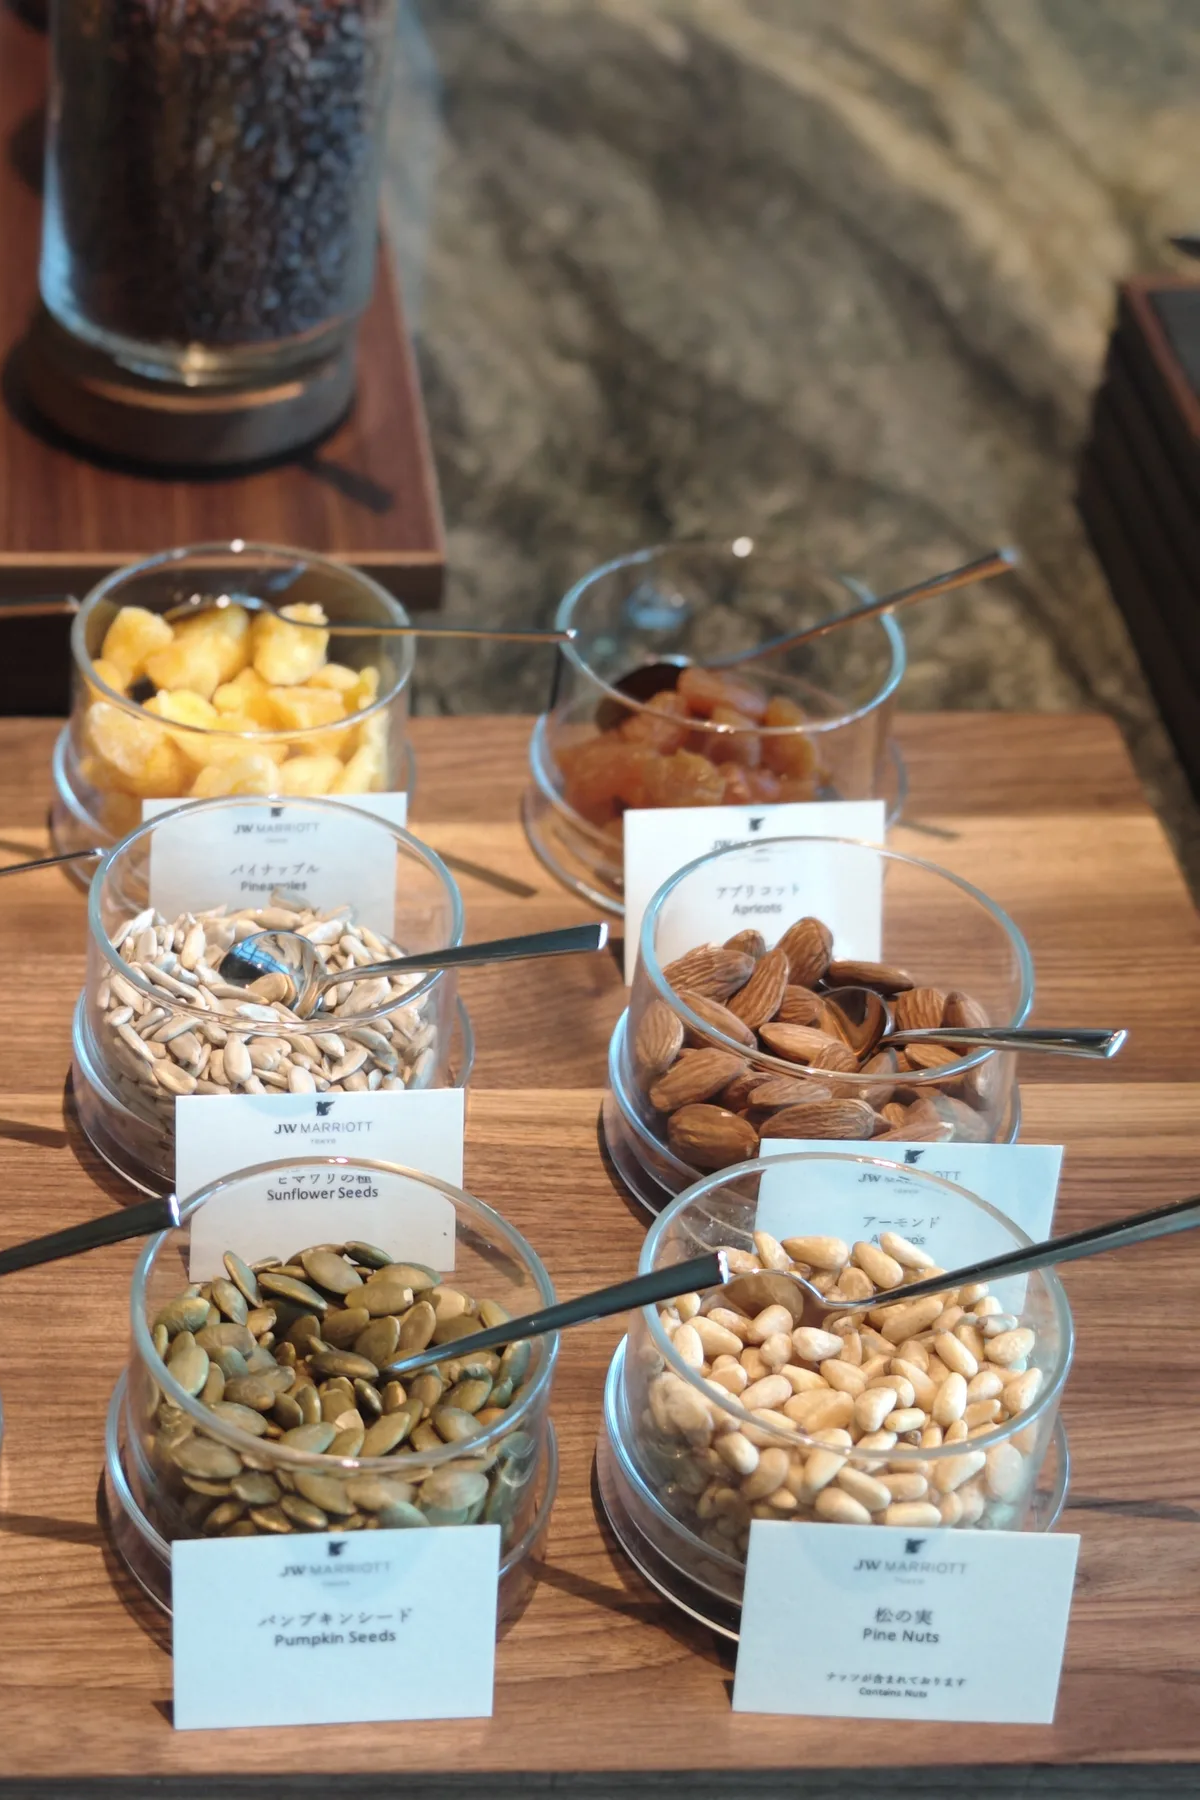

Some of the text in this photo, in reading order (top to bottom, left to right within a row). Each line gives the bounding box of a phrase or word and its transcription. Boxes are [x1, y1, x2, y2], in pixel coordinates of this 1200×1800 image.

[233, 822, 320, 835] JW MARRIOTT
[732, 903, 783, 915] Apricots
[274, 1121, 373, 1135] JW MARRIOTT
[858, 1173, 881, 1183] JW
[266, 1186, 379, 1201] Sunflower Seeds
[862, 1216, 941, 1229] アーモンド
[279, 1561, 392, 1577] JW MARRIOTT
[853, 1559, 968, 1575] JW MARRIOTT
[874, 1606, 934, 1626] 松の実
[274, 1629, 397, 1648] Pumpkin Seeds
[863, 1627, 940, 1643] Pine Nuts
[859, 1686, 928, 1698] Contains Nuts
